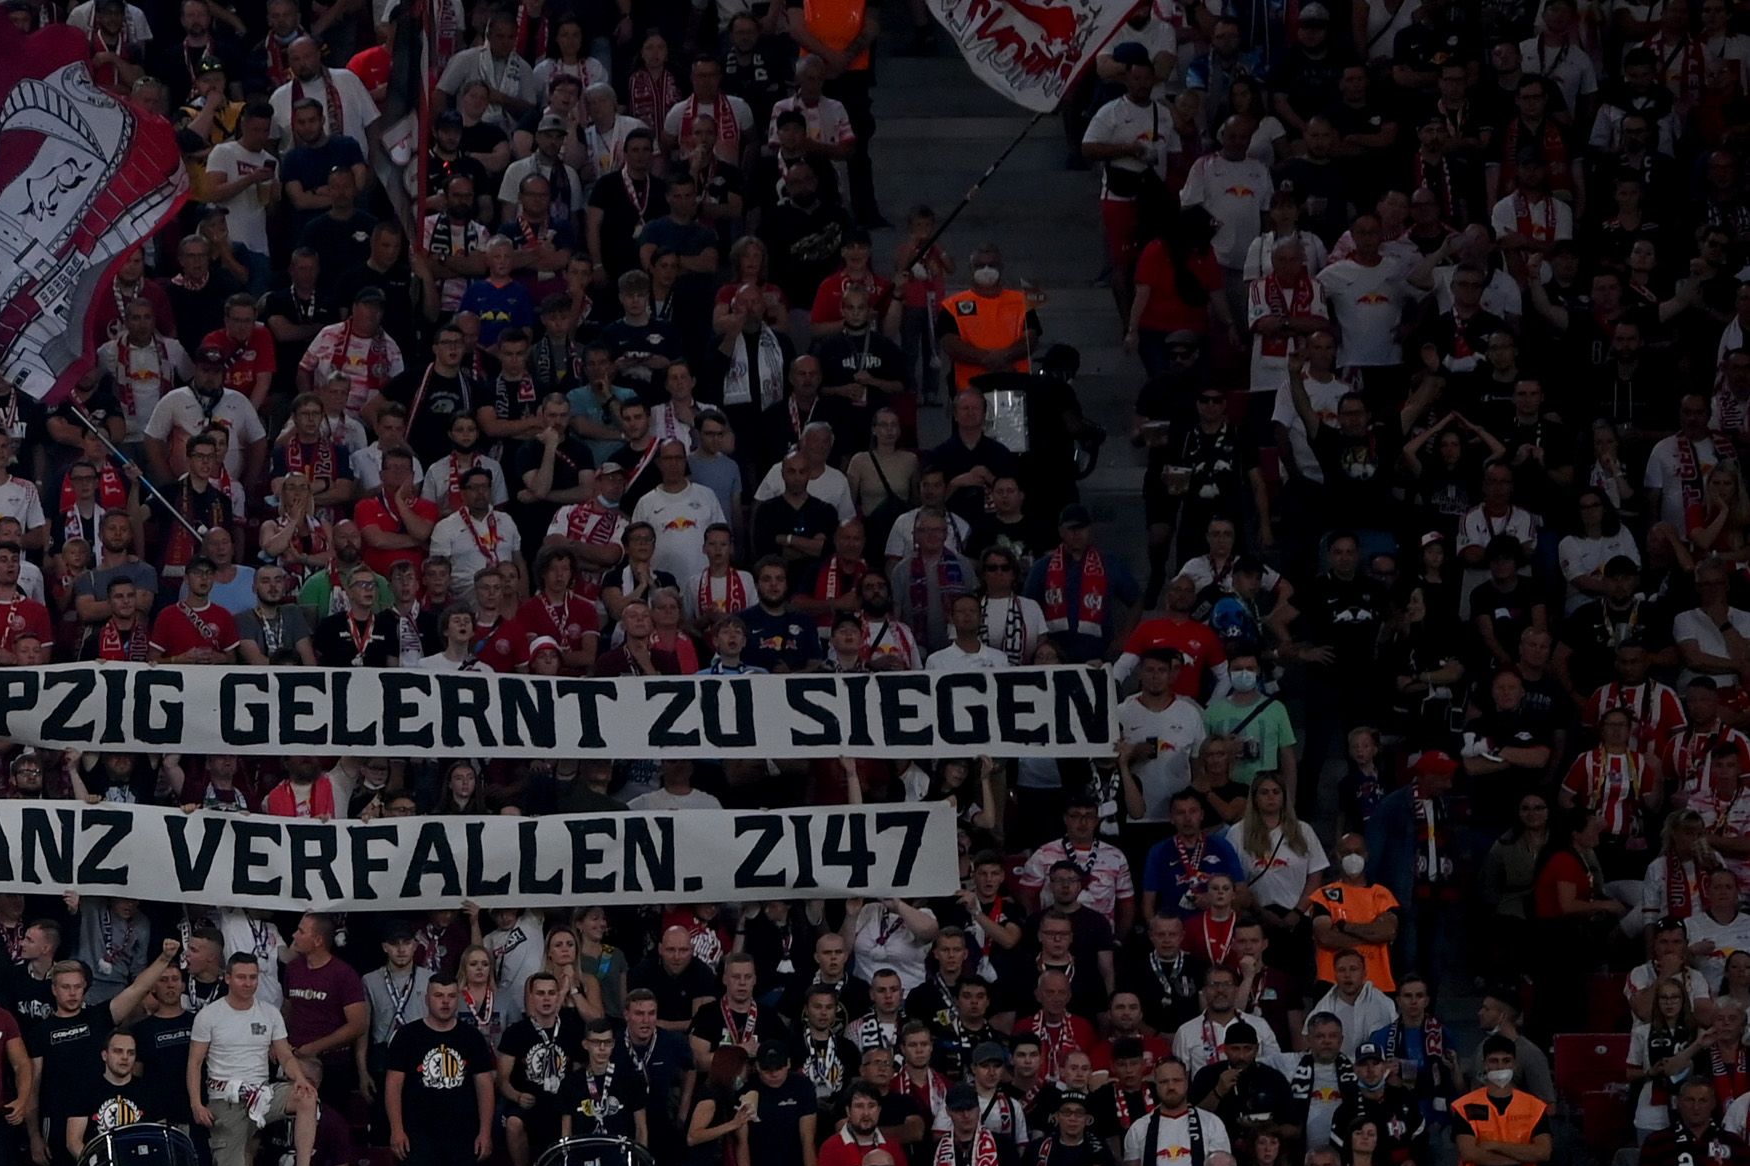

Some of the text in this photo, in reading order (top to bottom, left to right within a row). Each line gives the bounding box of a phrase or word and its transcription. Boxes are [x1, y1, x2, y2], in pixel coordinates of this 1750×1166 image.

[220, 672, 617, 747] GELERNT
[645, 676, 755, 746] ZU
[786, 667, 1110, 746] SIEGEN
[165, 813, 703, 902] VERFALLEN.
